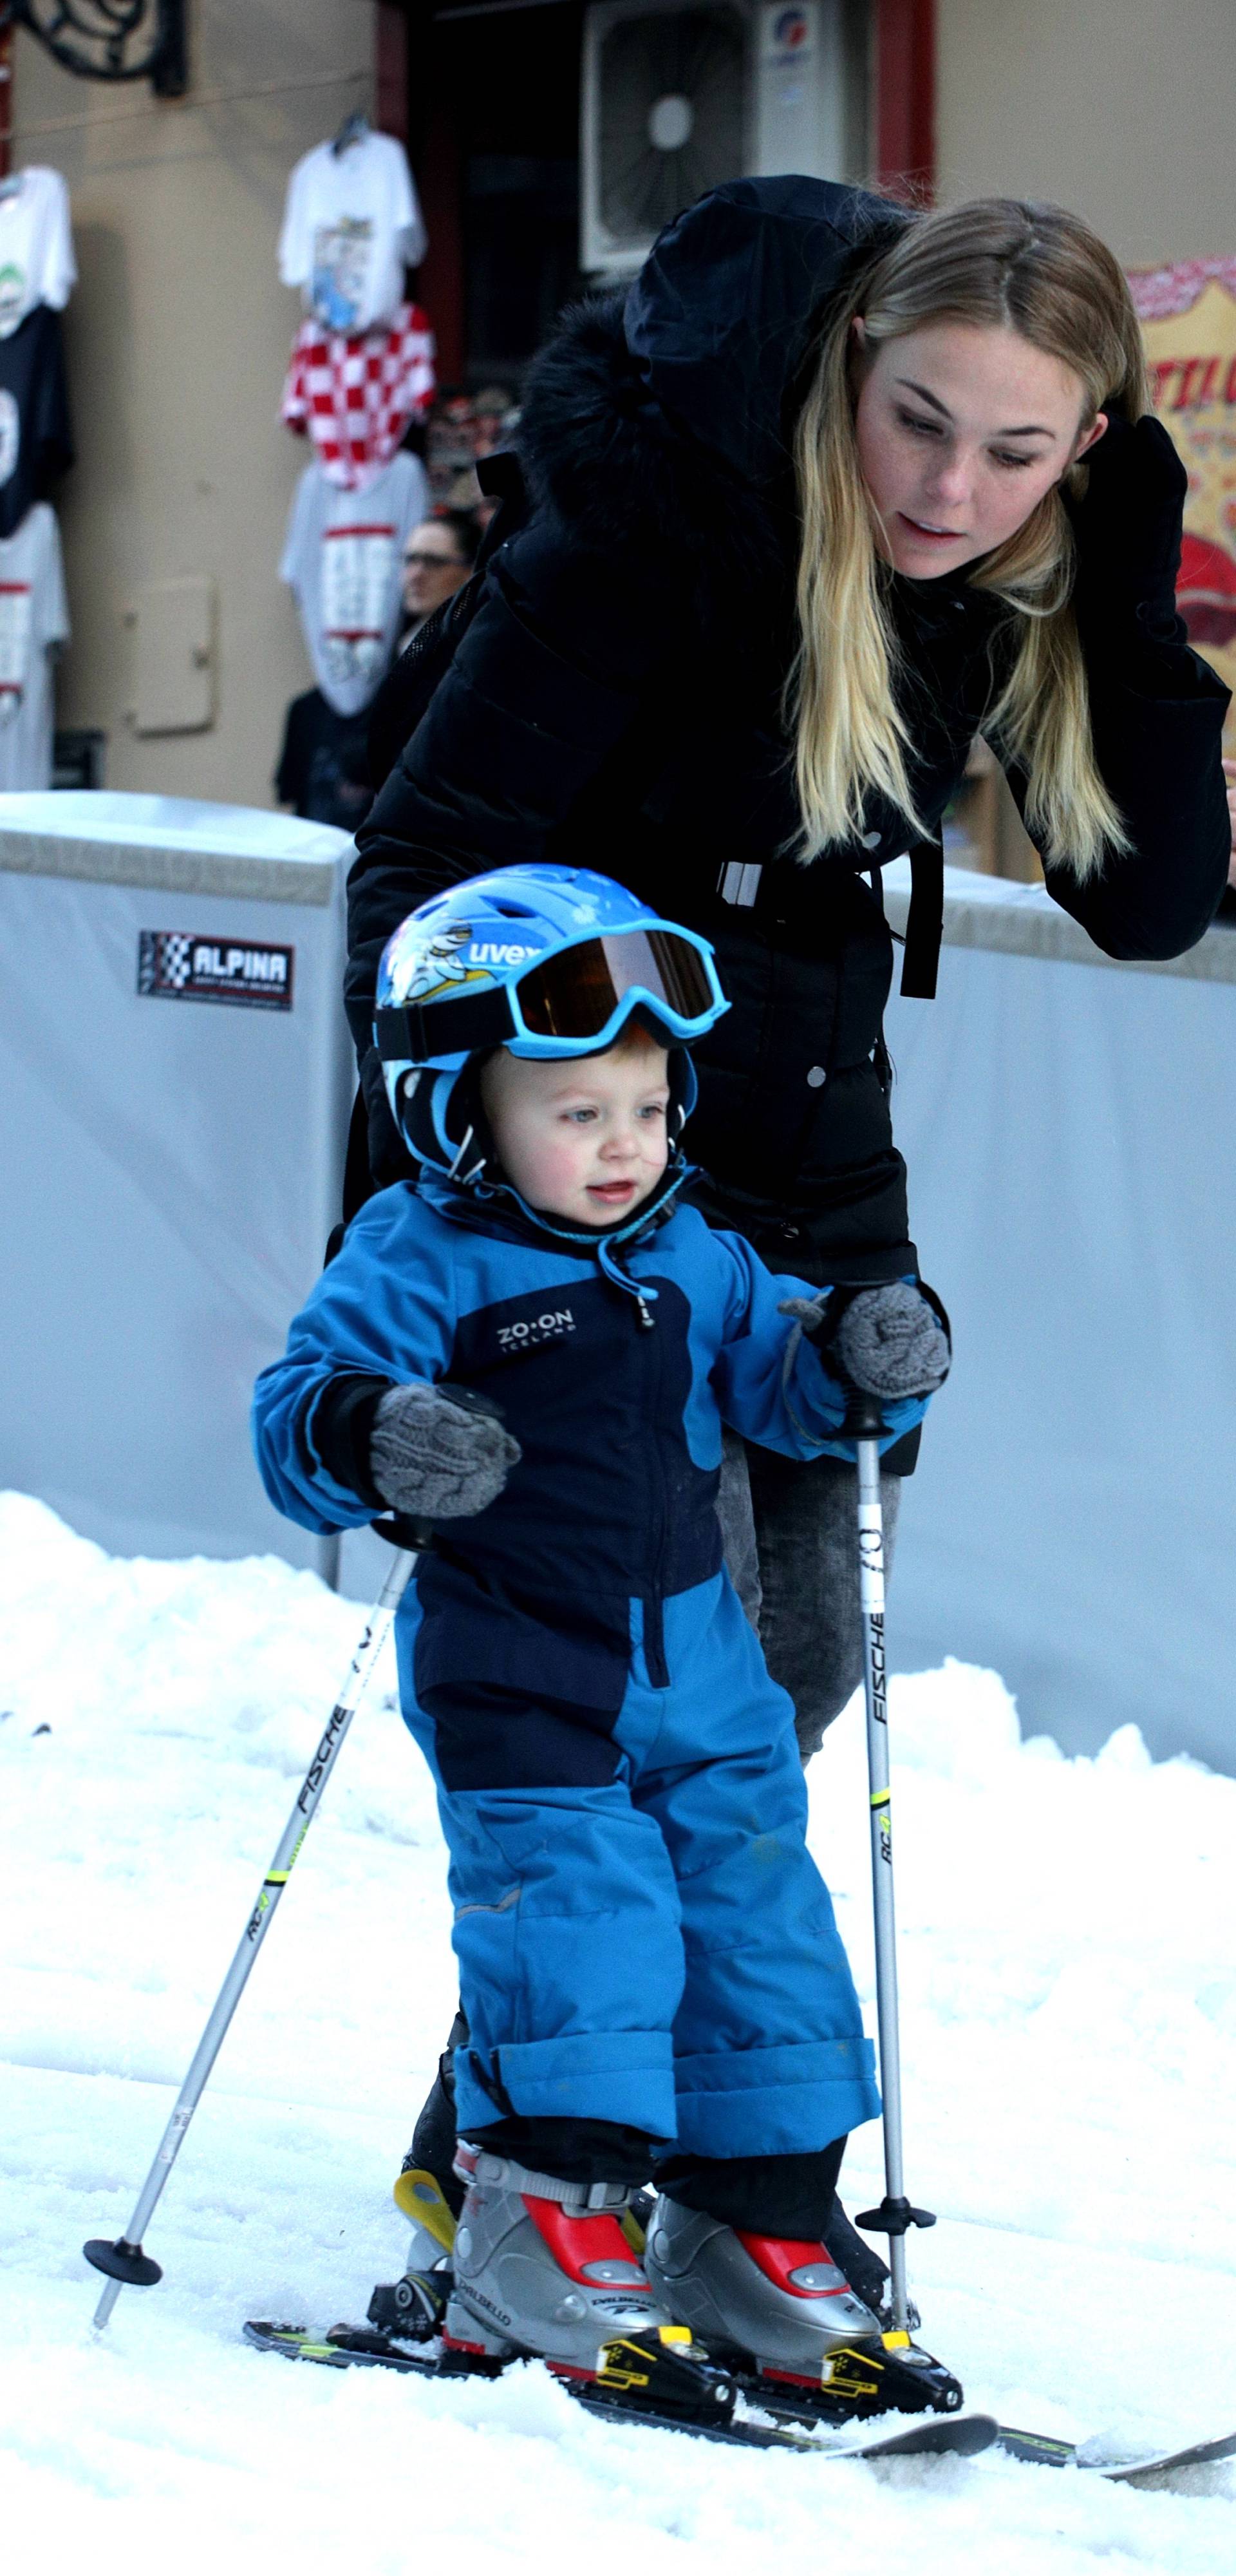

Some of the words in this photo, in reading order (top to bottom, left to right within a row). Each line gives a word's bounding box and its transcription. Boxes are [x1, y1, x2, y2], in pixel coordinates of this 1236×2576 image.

[194, 945, 287, 983] ALPINA
[501, 1323, 577, 1353] ICELAND
[879, 1813, 893, 1866] RC4
[458, 2278, 512, 2327] DALBELLO
